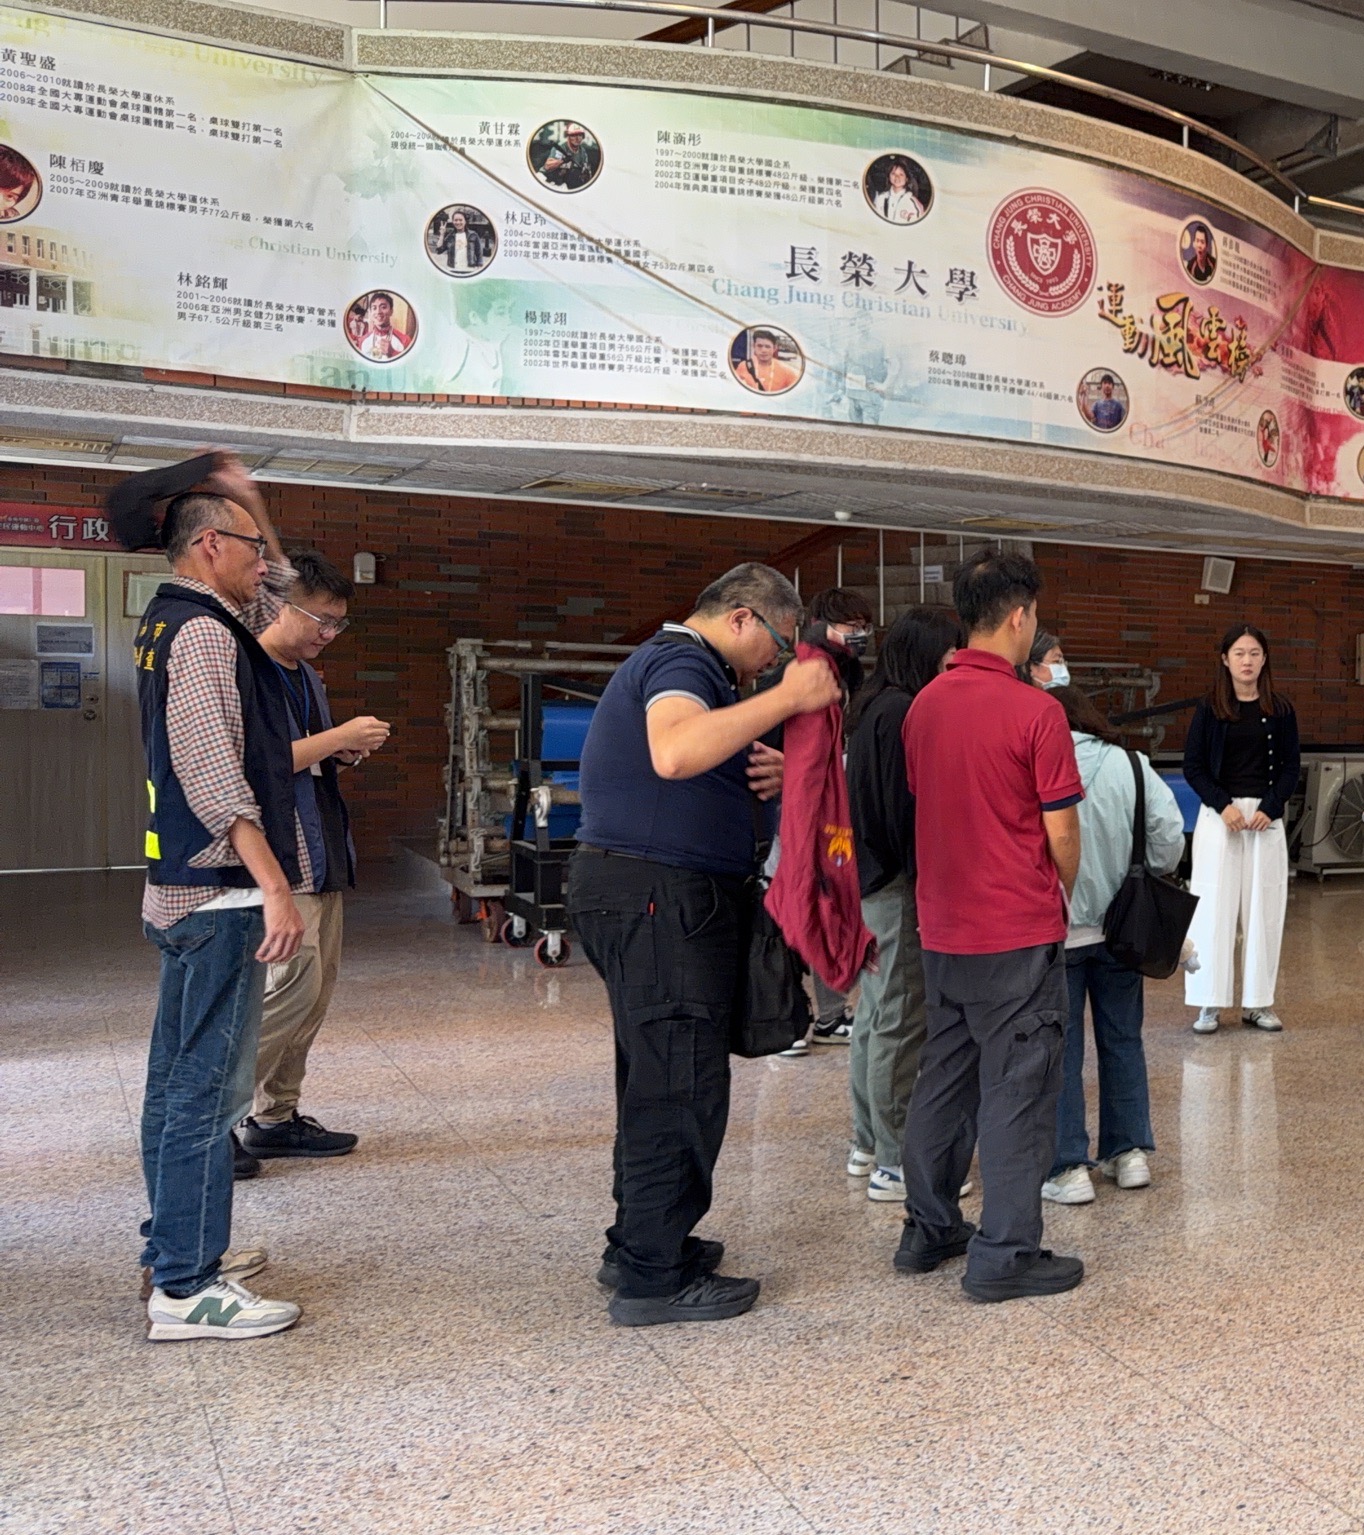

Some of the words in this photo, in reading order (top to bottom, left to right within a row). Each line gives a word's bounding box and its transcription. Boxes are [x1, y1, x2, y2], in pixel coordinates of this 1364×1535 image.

[1, 49, 56, 71] 黃聖盛
[993, 216, 1006, 249] CHANG
[1004, 199, 1024, 217] JUNG
[1025, 195, 1069, 214] CHRISTIAN
[1069, 213, 1092, 267] UNIVERSITY
[177, 271, 228, 291] 林銘輝
[784, 244, 978, 303] 長榮大學
[712, 278, 779, 305] Chang
[784, 285, 835, 310] Jung
[842, 291, 931, 319] Christian
[938, 306, 1029, 335] University
[1002, 275, 1026, 300] CHANG
[1028, 298, 1049, 310] JUNG
[1051, 290, 1082, 311] ACADEMY
[49, 515, 110, 541] 行政
